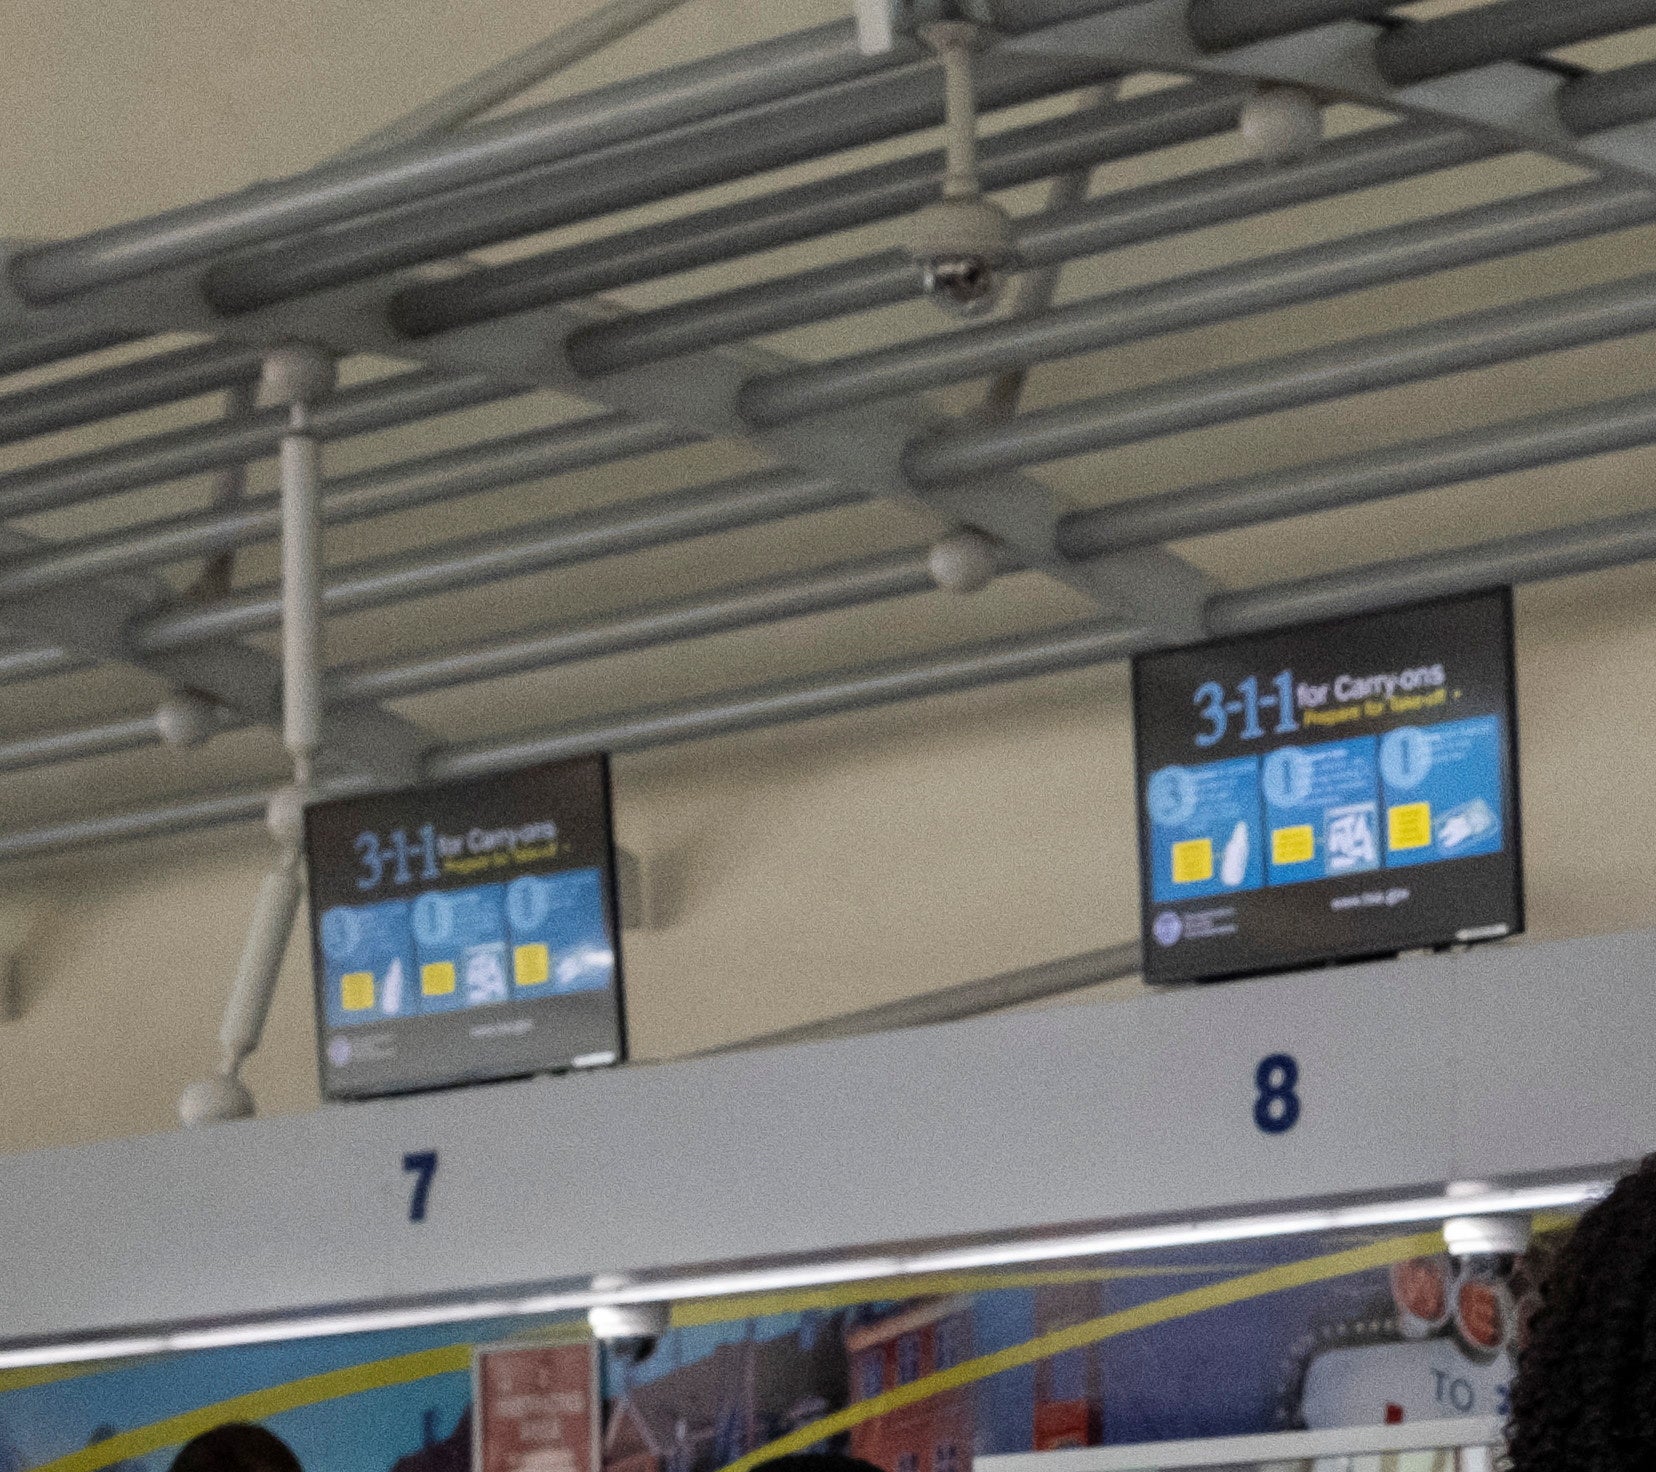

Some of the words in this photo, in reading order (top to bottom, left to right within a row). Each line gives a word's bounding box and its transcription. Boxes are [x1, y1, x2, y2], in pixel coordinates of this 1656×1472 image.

[1193, 667, 1300, 748] 3-1-1
[1333, 662, 1446, 703] Carry-ons
[1252, 1052, 1301, 1135] 8
[402, 1150, 439, 1223] 7
